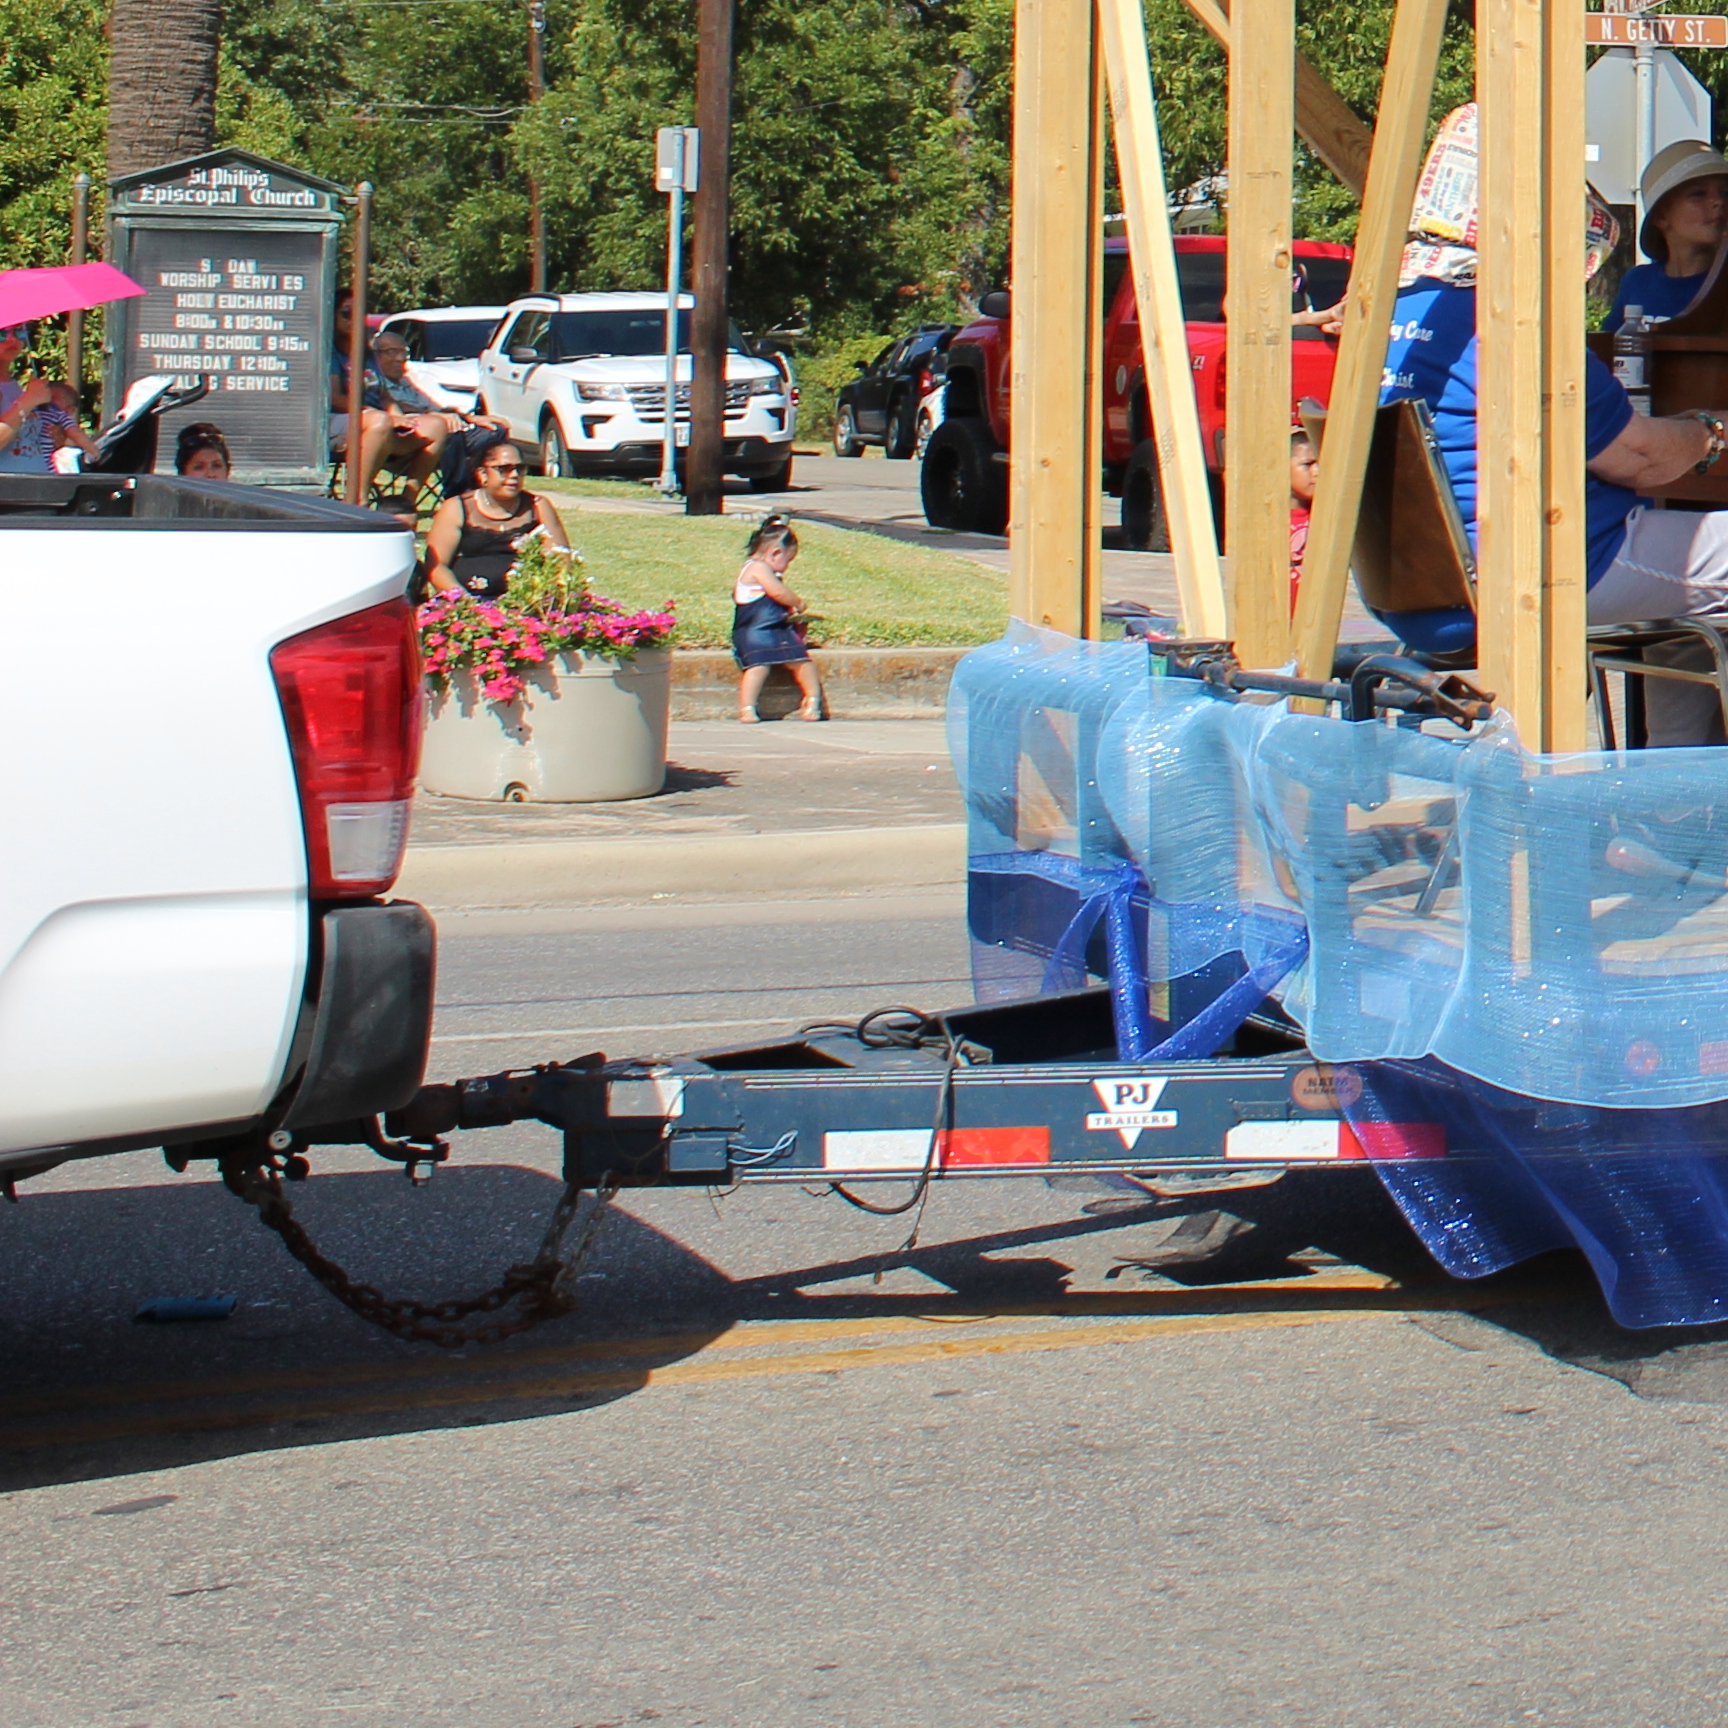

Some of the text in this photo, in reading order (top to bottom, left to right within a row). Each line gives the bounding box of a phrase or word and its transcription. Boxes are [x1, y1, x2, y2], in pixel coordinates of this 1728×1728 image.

[1601, 18, 1711, 43] N. GETTY ST.
[139, 183, 317, 207] Episcopal Church
[158, 272, 222, 288] WORSHIP
[175, 292, 298, 311] HOLY EUCHARIST
[138, 333, 199, 349] SUNDAY
[203, 334, 262, 350] SCHOOL
[152, 354, 232, 371] THURSDAY
[225, 375, 291, 392] SERVICE
[1113, 1083, 1152, 1105] PJ
[1094, 1115, 1170, 1127] TRAILERS
